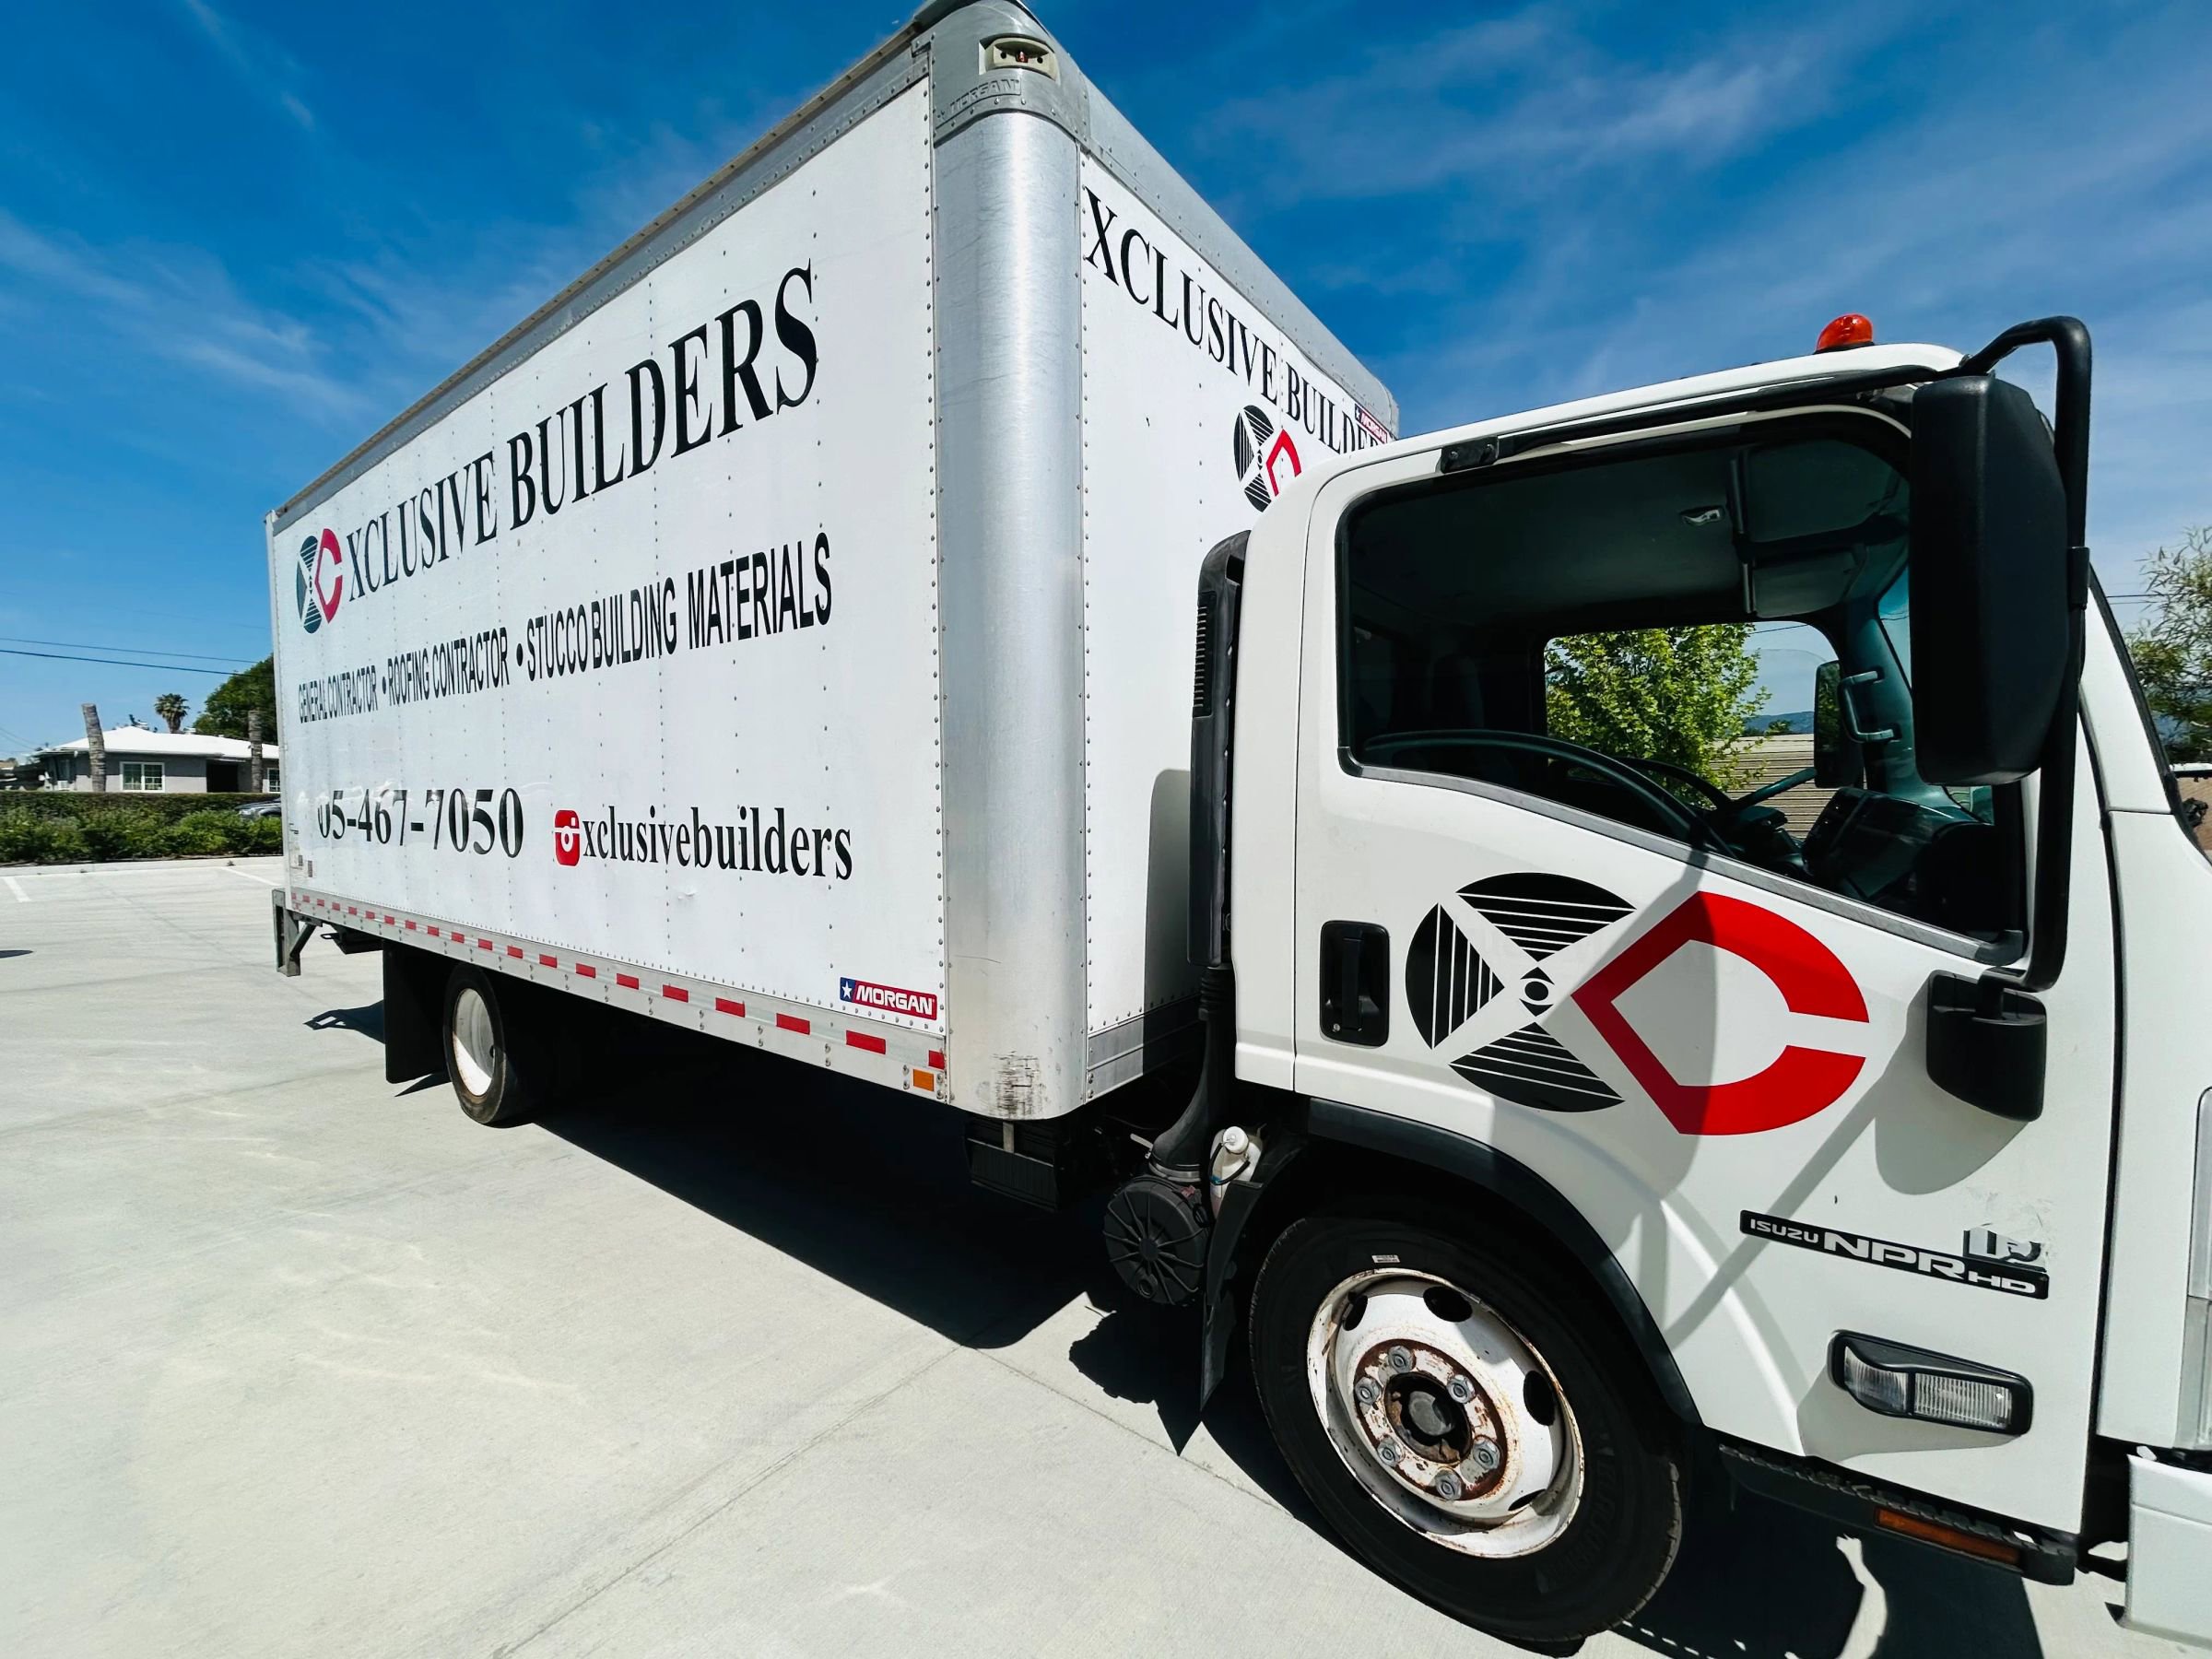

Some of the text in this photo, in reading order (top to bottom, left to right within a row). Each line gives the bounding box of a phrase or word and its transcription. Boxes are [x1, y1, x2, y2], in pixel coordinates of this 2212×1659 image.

[1085, 185, 1278, 406] XCLUSIVE
[347, 451, 498, 602] XCLUSIVE
[507, 258, 818, 530] BUILDERS
[327, 665, 379, 718] CONTRACTOR
[387, 648, 430, 706] ROOFING
[432, 627, 510, 698] CONTRACTOR
[527, 604, 589, 682] STUCCO
[592, 577, 677, 669] BUILDING
[688, 532, 831, 650] MATERIALS
[582, 805, 853, 880] xclusivebuilders
[856, 984, 934, 1016] MORGAN
[1750, 1218, 1819, 1244] ISUZU
[1824, 1231, 1967, 1280] NPR
[1968, 1271, 2036, 1294] HD
